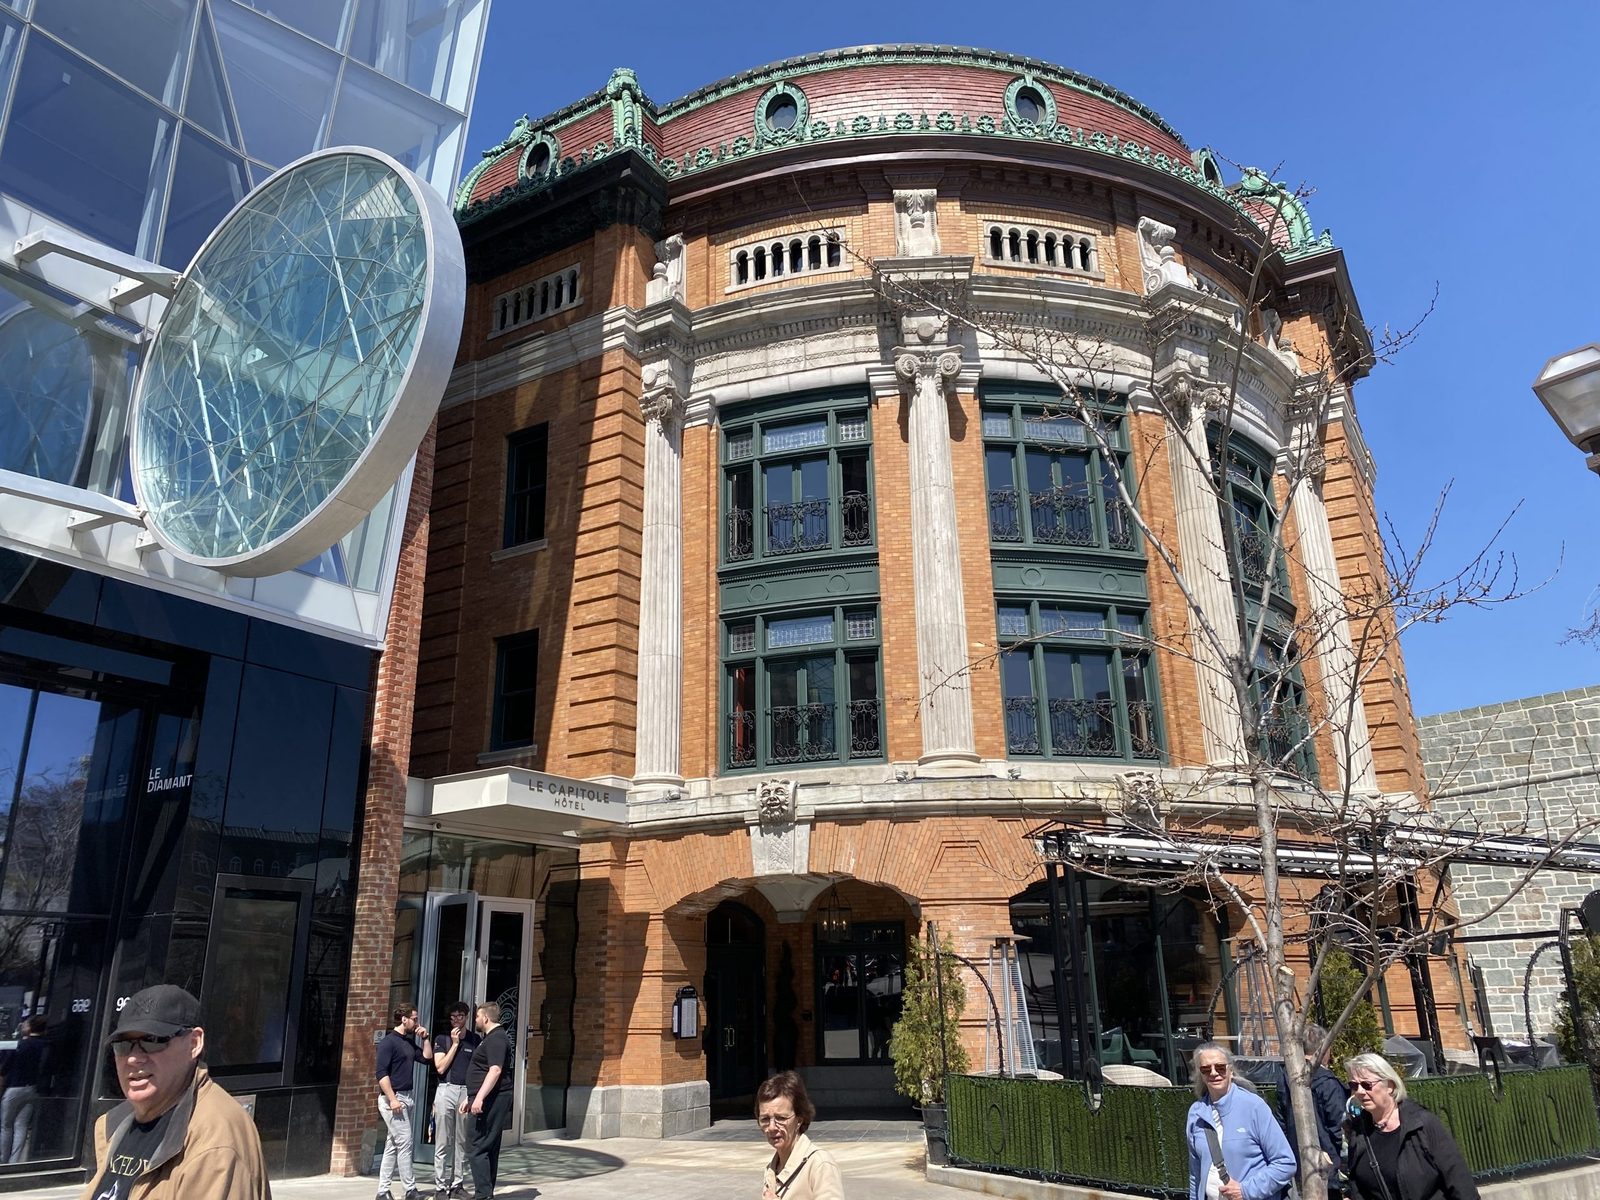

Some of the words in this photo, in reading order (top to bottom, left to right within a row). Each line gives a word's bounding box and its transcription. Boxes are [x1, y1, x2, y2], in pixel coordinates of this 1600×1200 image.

[149, 767, 161, 780] LE
[147, 774, 193, 793] DIAMANT
[528, 779, 544, 793] LE
[548, 783, 610, 804] CAPITOLE
[554, 797, 586, 811] HÔTEL
